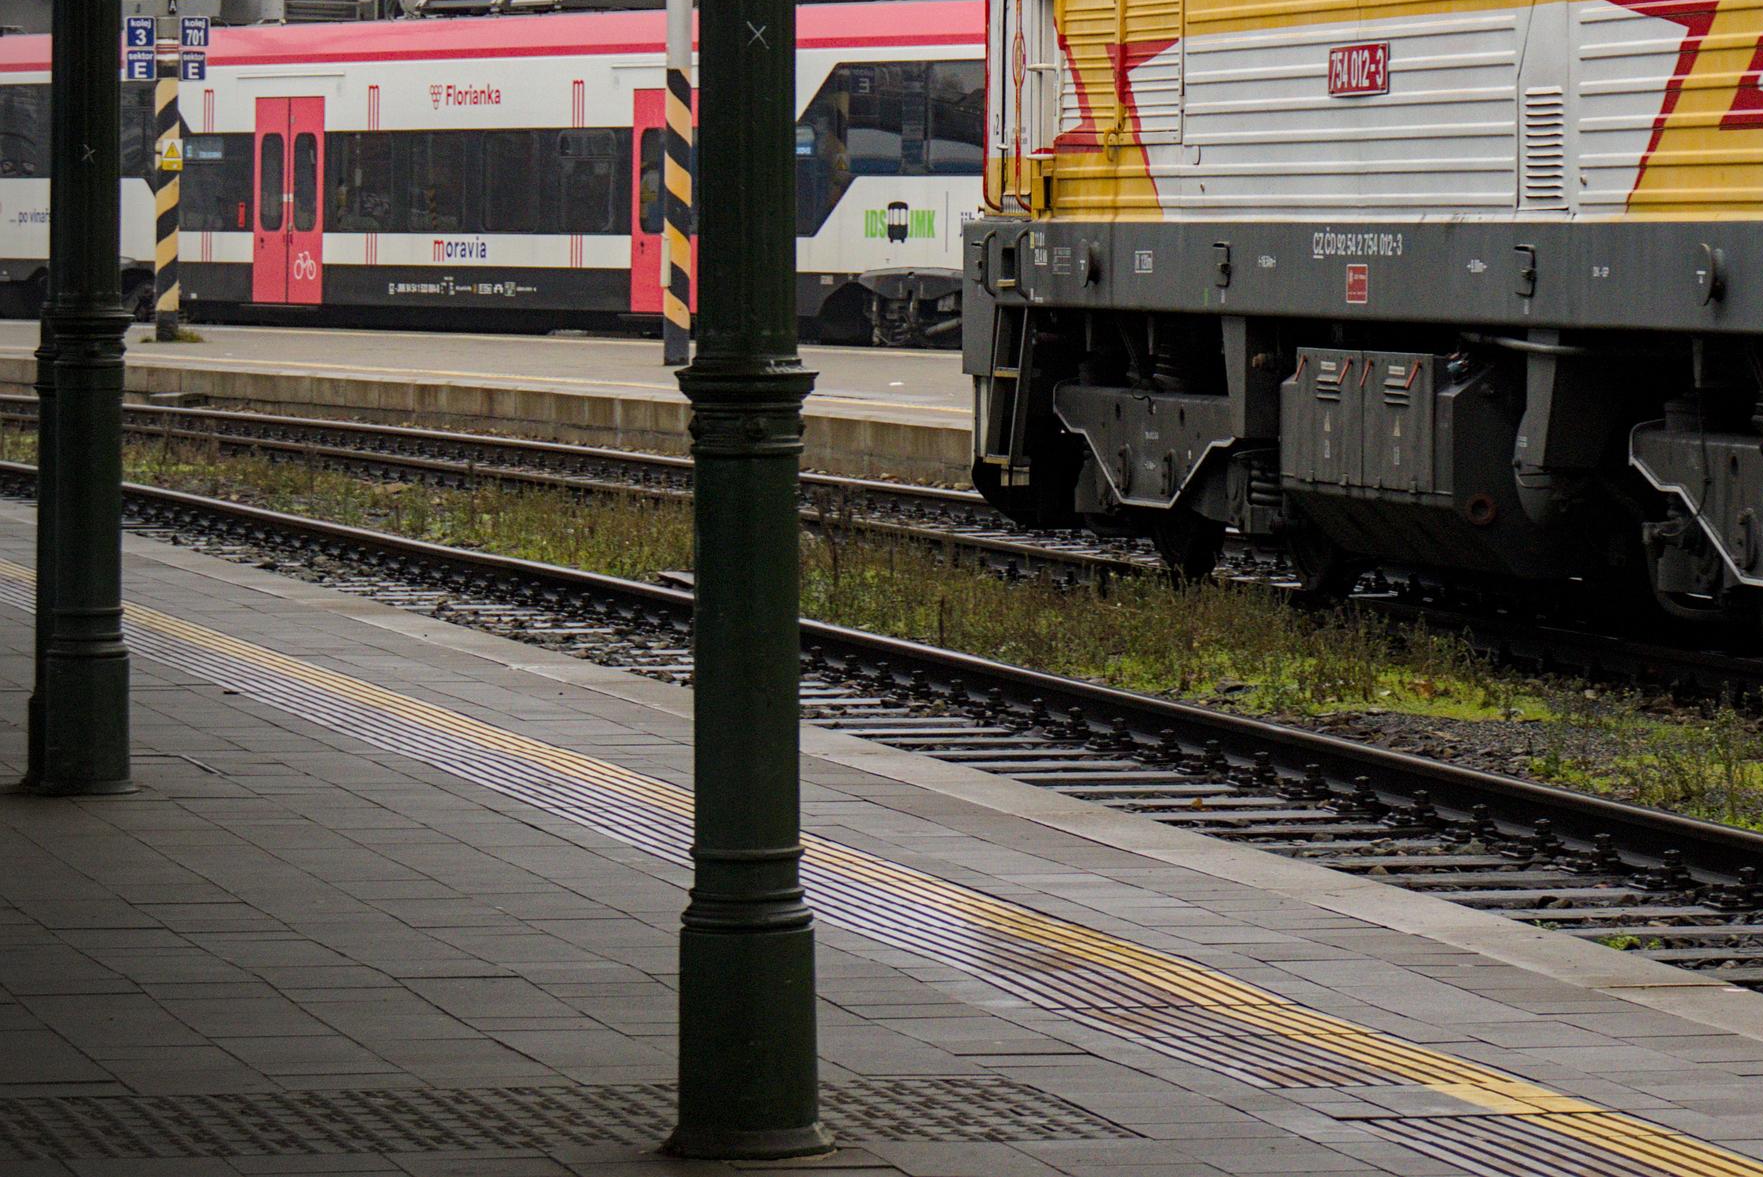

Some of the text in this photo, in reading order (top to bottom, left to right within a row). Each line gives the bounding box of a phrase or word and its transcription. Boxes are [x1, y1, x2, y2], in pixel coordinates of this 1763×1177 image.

[131, 19, 152, 29] kolej
[184, 19, 206, 29] kolej
[135, 29, 147, 46] 3
[186, 29, 204, 46] 701
[128, 52, 154, 61] sektor
[182, 53, 205, 61] sektor
[134, 62, 147, 78] E
[188, 62, 200, 79] E
[1331, 48, 1384, 89] 754 012-3
[446, 83, 501, 106] Florianka
[864, 209, 886, 239] IDS
[908, 209, 936, 239] JMK
[432, 236, 487, 262] moravia
[1313, 226, 1403, 256] CZ ČD 92 54 2 754 012-3
